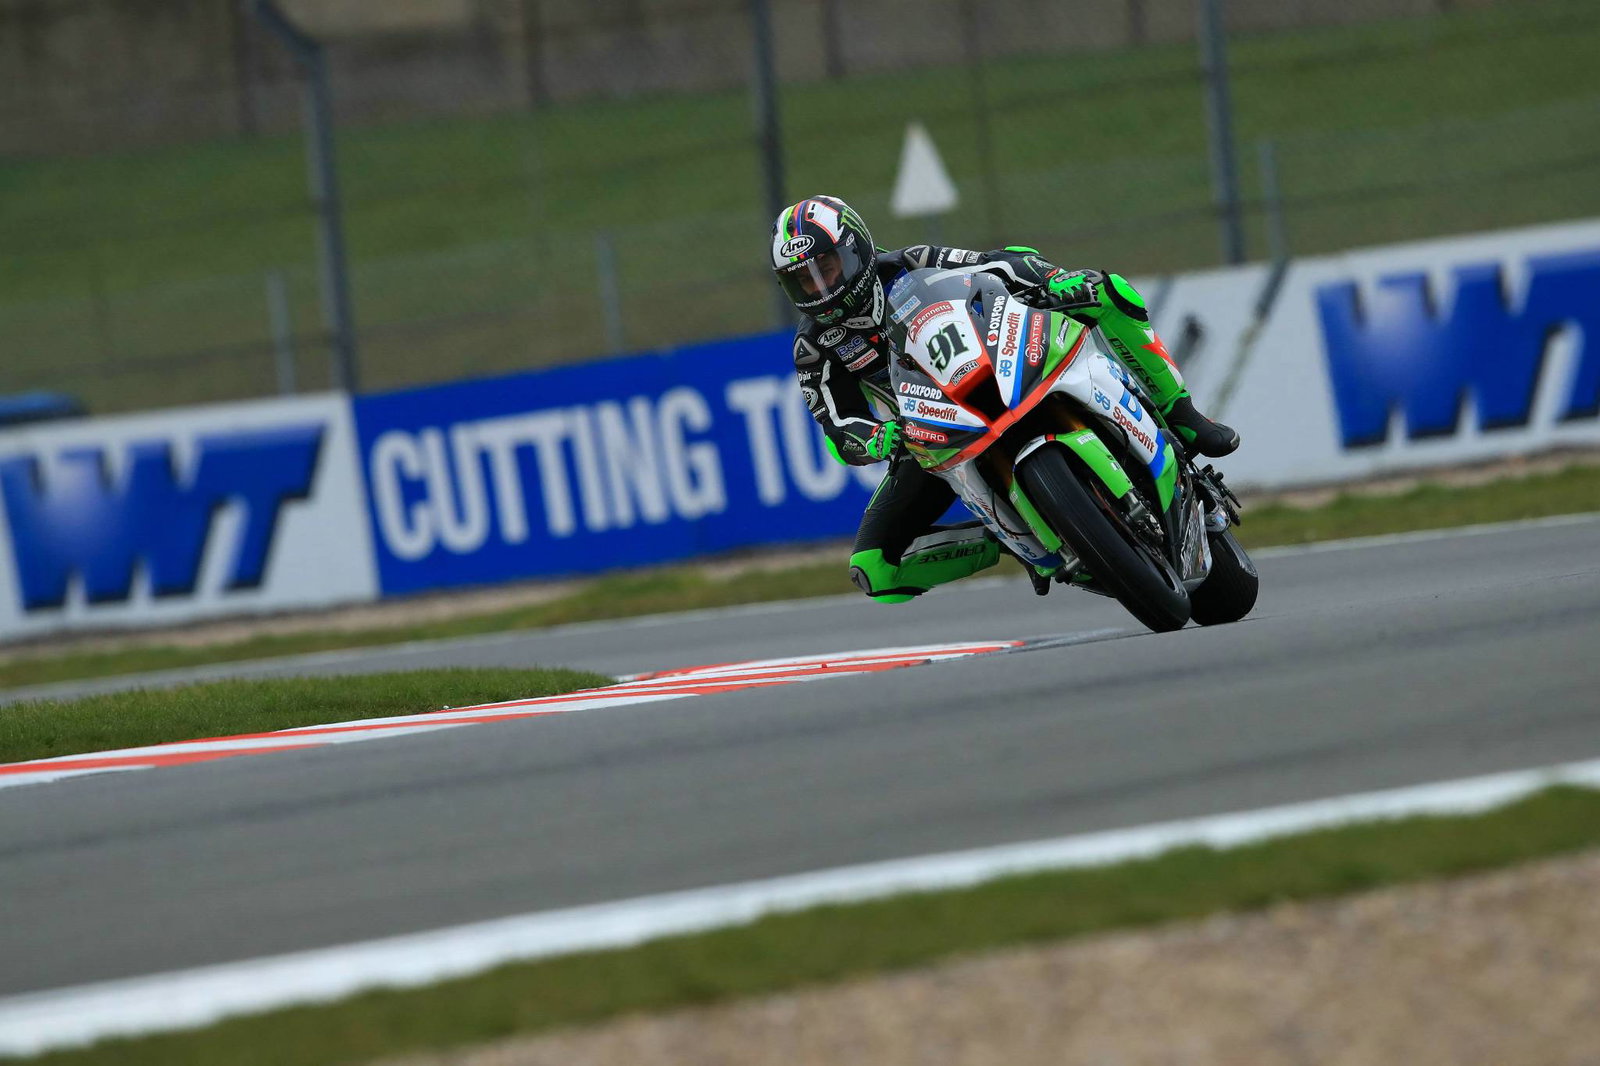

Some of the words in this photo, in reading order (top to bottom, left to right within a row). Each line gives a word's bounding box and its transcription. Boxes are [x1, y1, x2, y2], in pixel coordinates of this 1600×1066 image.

[784, 237, 808, 254] Arai
[989, 295, 1006, 330] OXFORD
[822, 329, 841, 345] Arai
[925, 323, 970, 375] 91
[1001, 312, 1021, 357] Speedfit
[1029, 314, 1042, 363] QUATTRO
[1108, 337, 1161, 396] DAINESE
[909, 384, 942, 400] OXFORD
[917, 401, 958, 421] Speedfit
[905, 425, 945, 442] QUATTRO
[1113, 406, 1155, 453] Speedfit
[369, 386, 726, 561] CUTTING
[724, 372, 882, 507] TO
